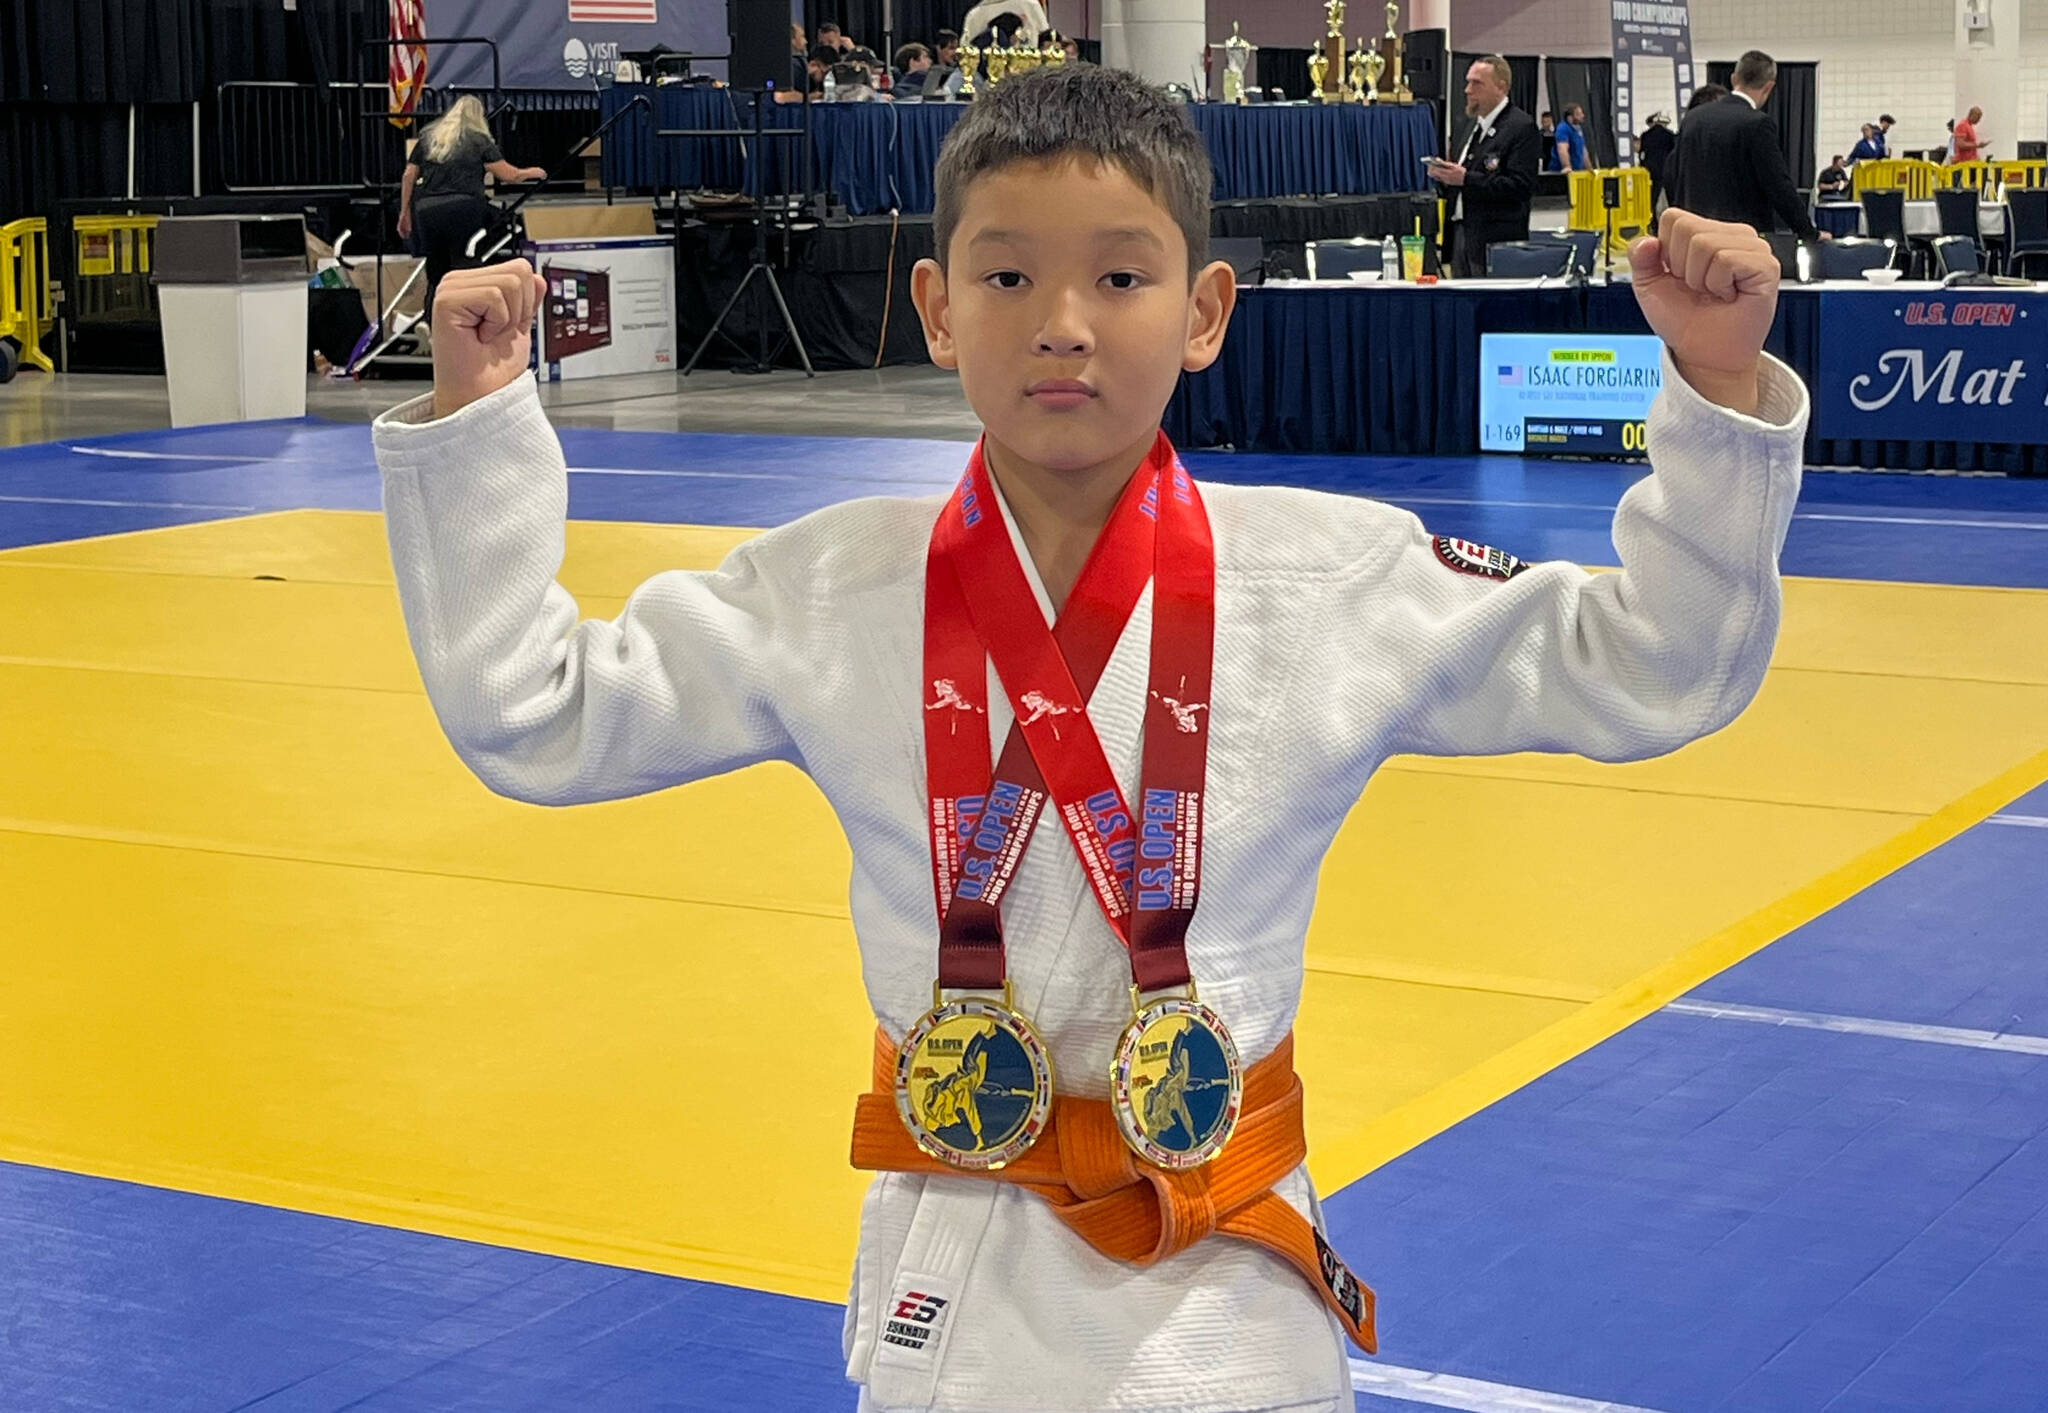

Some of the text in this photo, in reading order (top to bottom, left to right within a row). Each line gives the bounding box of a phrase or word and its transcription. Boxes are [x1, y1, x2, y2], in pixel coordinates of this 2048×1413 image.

[588, 42, 618, 59] VISIT
[1904, 302, 2015, 326] U.S. OPEN
[1528, 365, 1571, 386] ISAAC
[1850, 349, 2026, 411] Mat
[933, 798, 946, 826] JUDO
[956, 780, 1023, 900] U.S. OPEN
[1085, 789, 1128, 843] U.S.
[986, 790, 1043, 906] JUDO CHAMPIONSHIPS
[1062, 803, 1123, 918] JUDO CHAMPIONSHIPS
[1137, 788, 1177, 910] U.S. OPEN
[1181, 792, 1199, 910] JUDO CHAMPIONSHIPS
